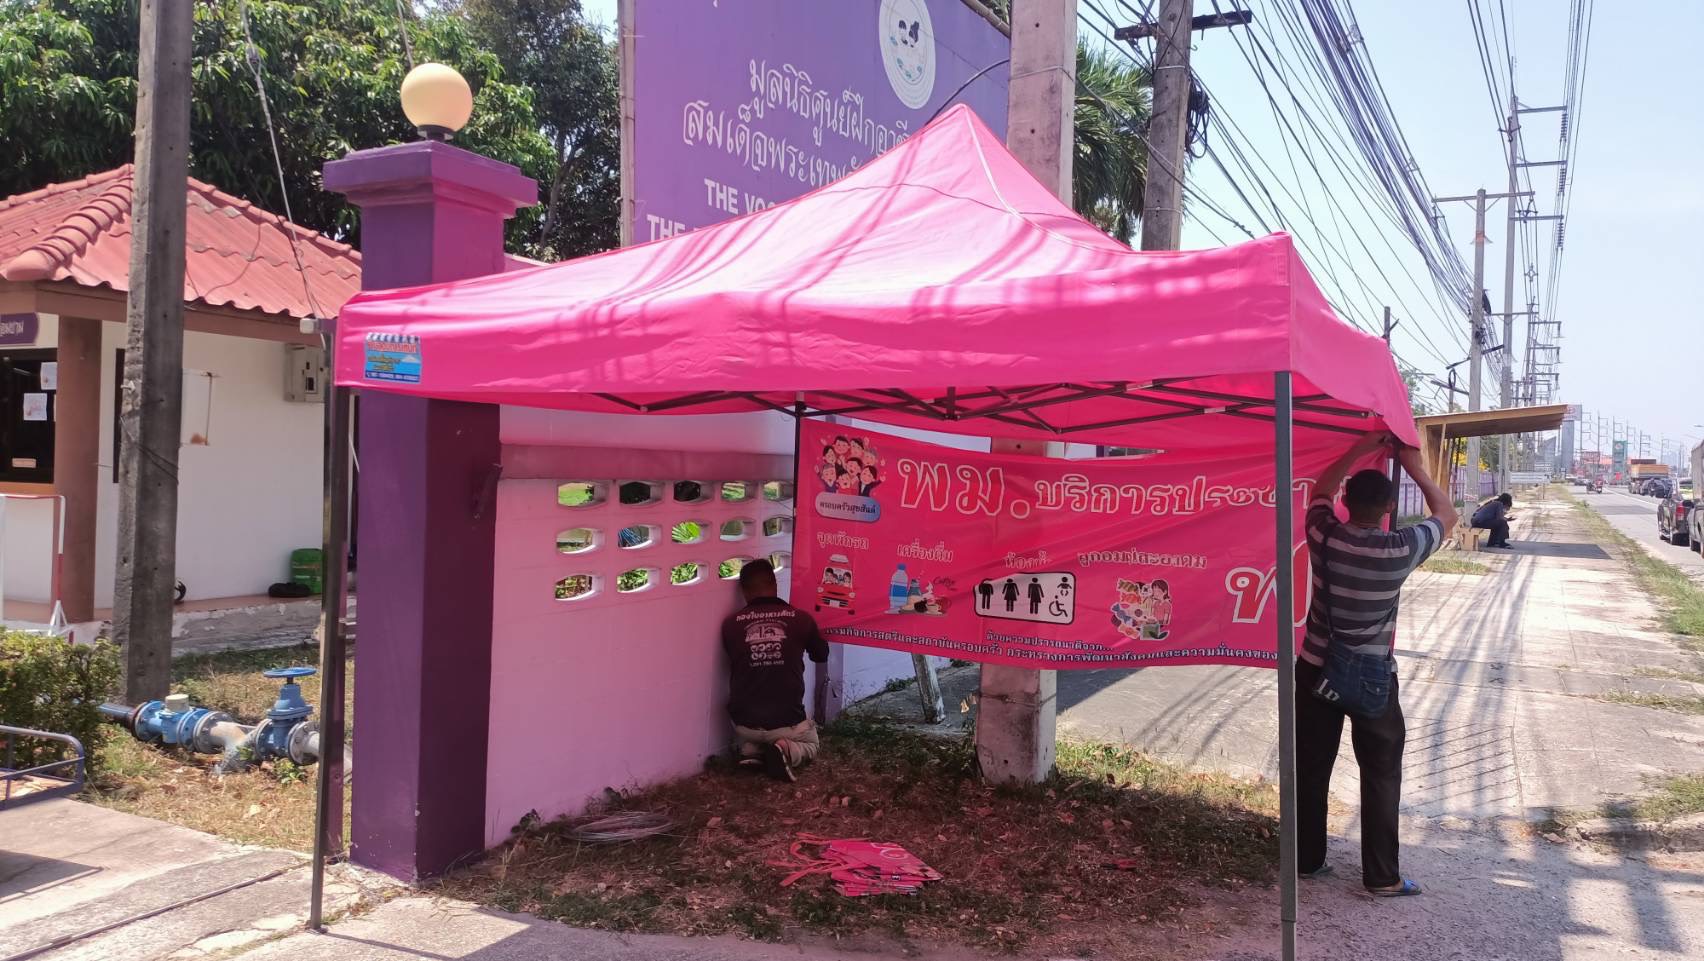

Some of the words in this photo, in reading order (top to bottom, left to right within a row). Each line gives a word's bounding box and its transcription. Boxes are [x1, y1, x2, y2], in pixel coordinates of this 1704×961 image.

[704, 178, 739, 215] THE
[646, 213, 686, 241] THE
[816, 530, 870, 550] จุดพักรถ
[896, 538, 954, 563] เครื่องดื่ม
